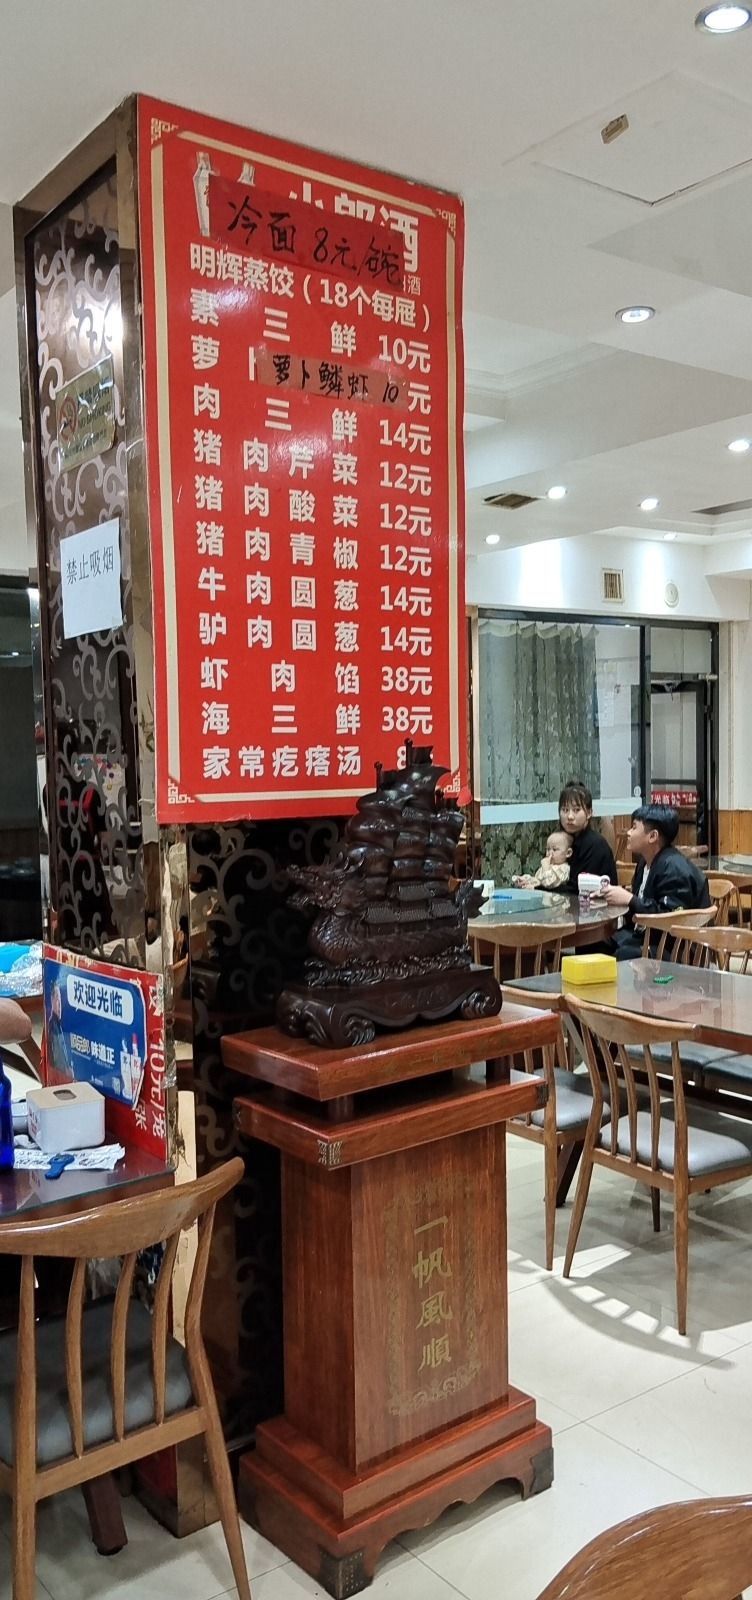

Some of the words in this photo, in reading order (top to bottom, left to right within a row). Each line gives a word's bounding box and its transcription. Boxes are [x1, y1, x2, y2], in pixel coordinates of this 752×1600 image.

[228, 195, 296, 254] 冷面
[378, 335, 431, 373] 10元
[382, 381, 400, 403] 10
[379, 419, 432, 456] 14元
[380, 461, 432, 496] 12元
[380, 503, 432, 537] 12元
[66, 546, 113, 585] 禁止吸烟
[380, 544, 432, 577] 12元
[380, 585, 432, 617] 14元
[380, 626, 432, 656] 14元
[381, 666, 432, 696] 38元
[382, 706, 432, 735] 38元
[202, 745, 361, 779] 家常疙瘩汤
[74, 981, 122, 1018] 欢迎光临
[91, 1041, 115, 1065] 味道正
[412, 1215, 453, 1373] 一帆風順
